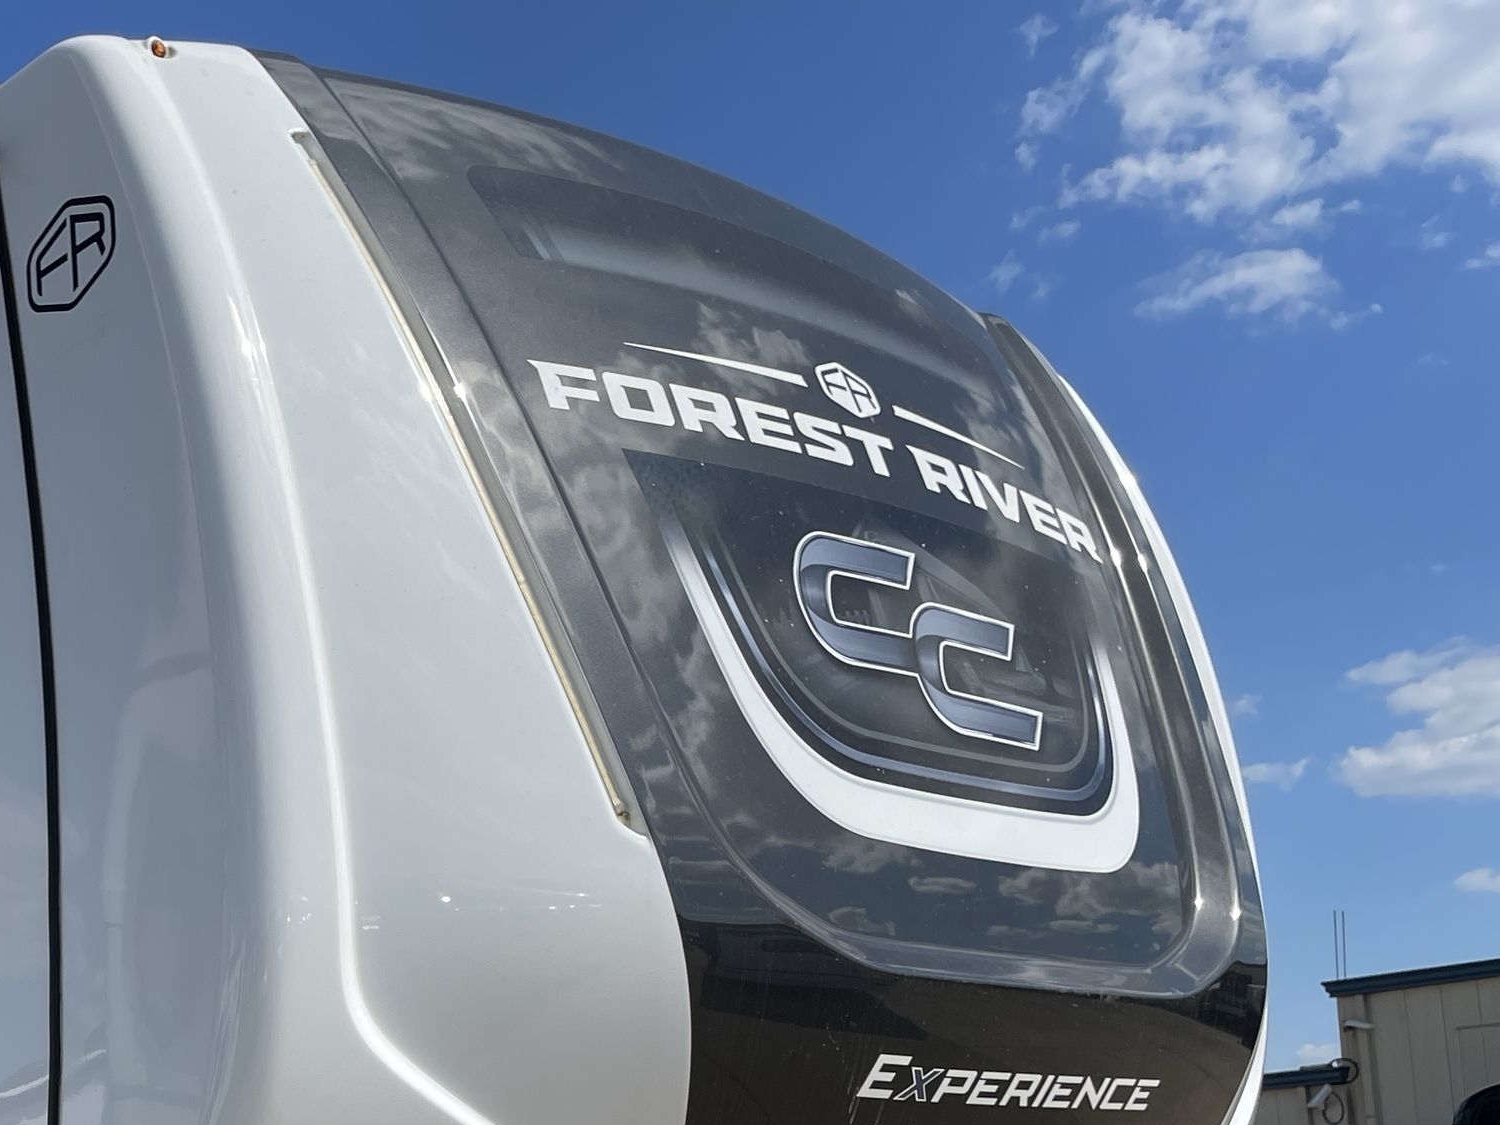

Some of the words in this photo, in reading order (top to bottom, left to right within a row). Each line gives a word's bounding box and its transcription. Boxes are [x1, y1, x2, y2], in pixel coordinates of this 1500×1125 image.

[527, 359, 894, 478] FOREST
[905, 443, 1105, 564] RIVER
[793, 531, 1044, 751] CC
[857, 1053, 1161, 1111] EXPERIENCE
